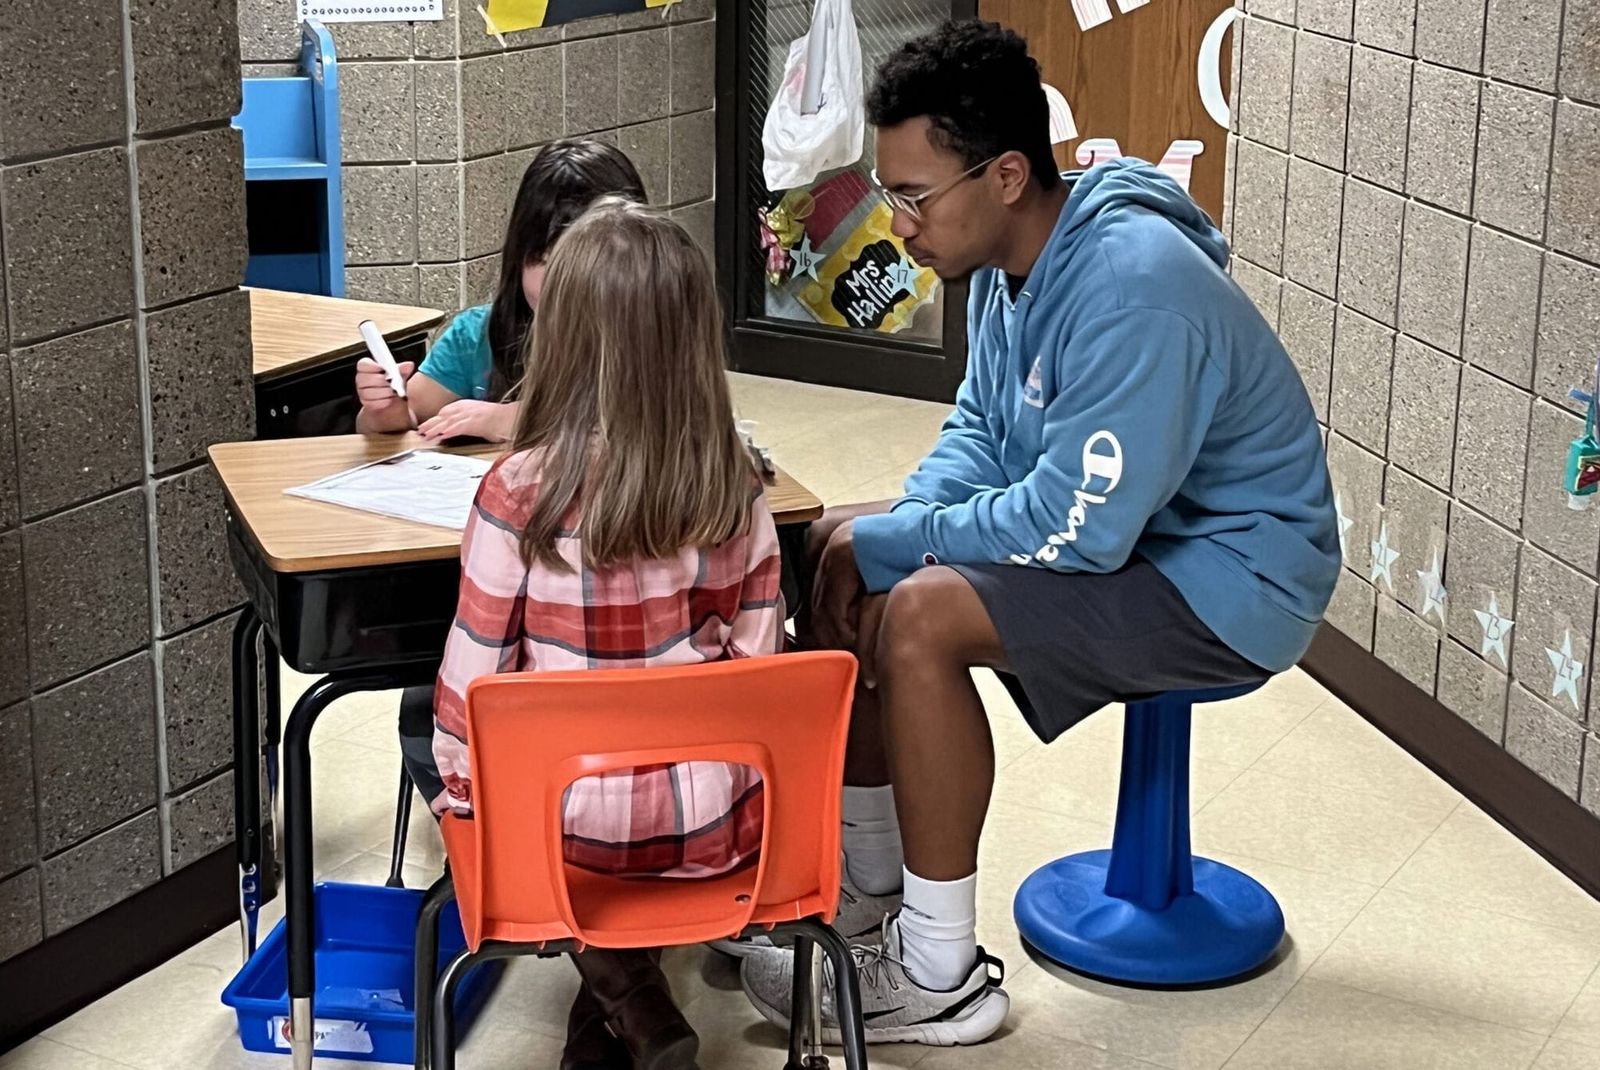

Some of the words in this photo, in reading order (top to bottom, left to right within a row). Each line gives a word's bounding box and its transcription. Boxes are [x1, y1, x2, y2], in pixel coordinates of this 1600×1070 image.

[799, 252, 812, 268] 16
[845, 259, 880, 297] Mrs
[897, 269, 909, 284] 17
